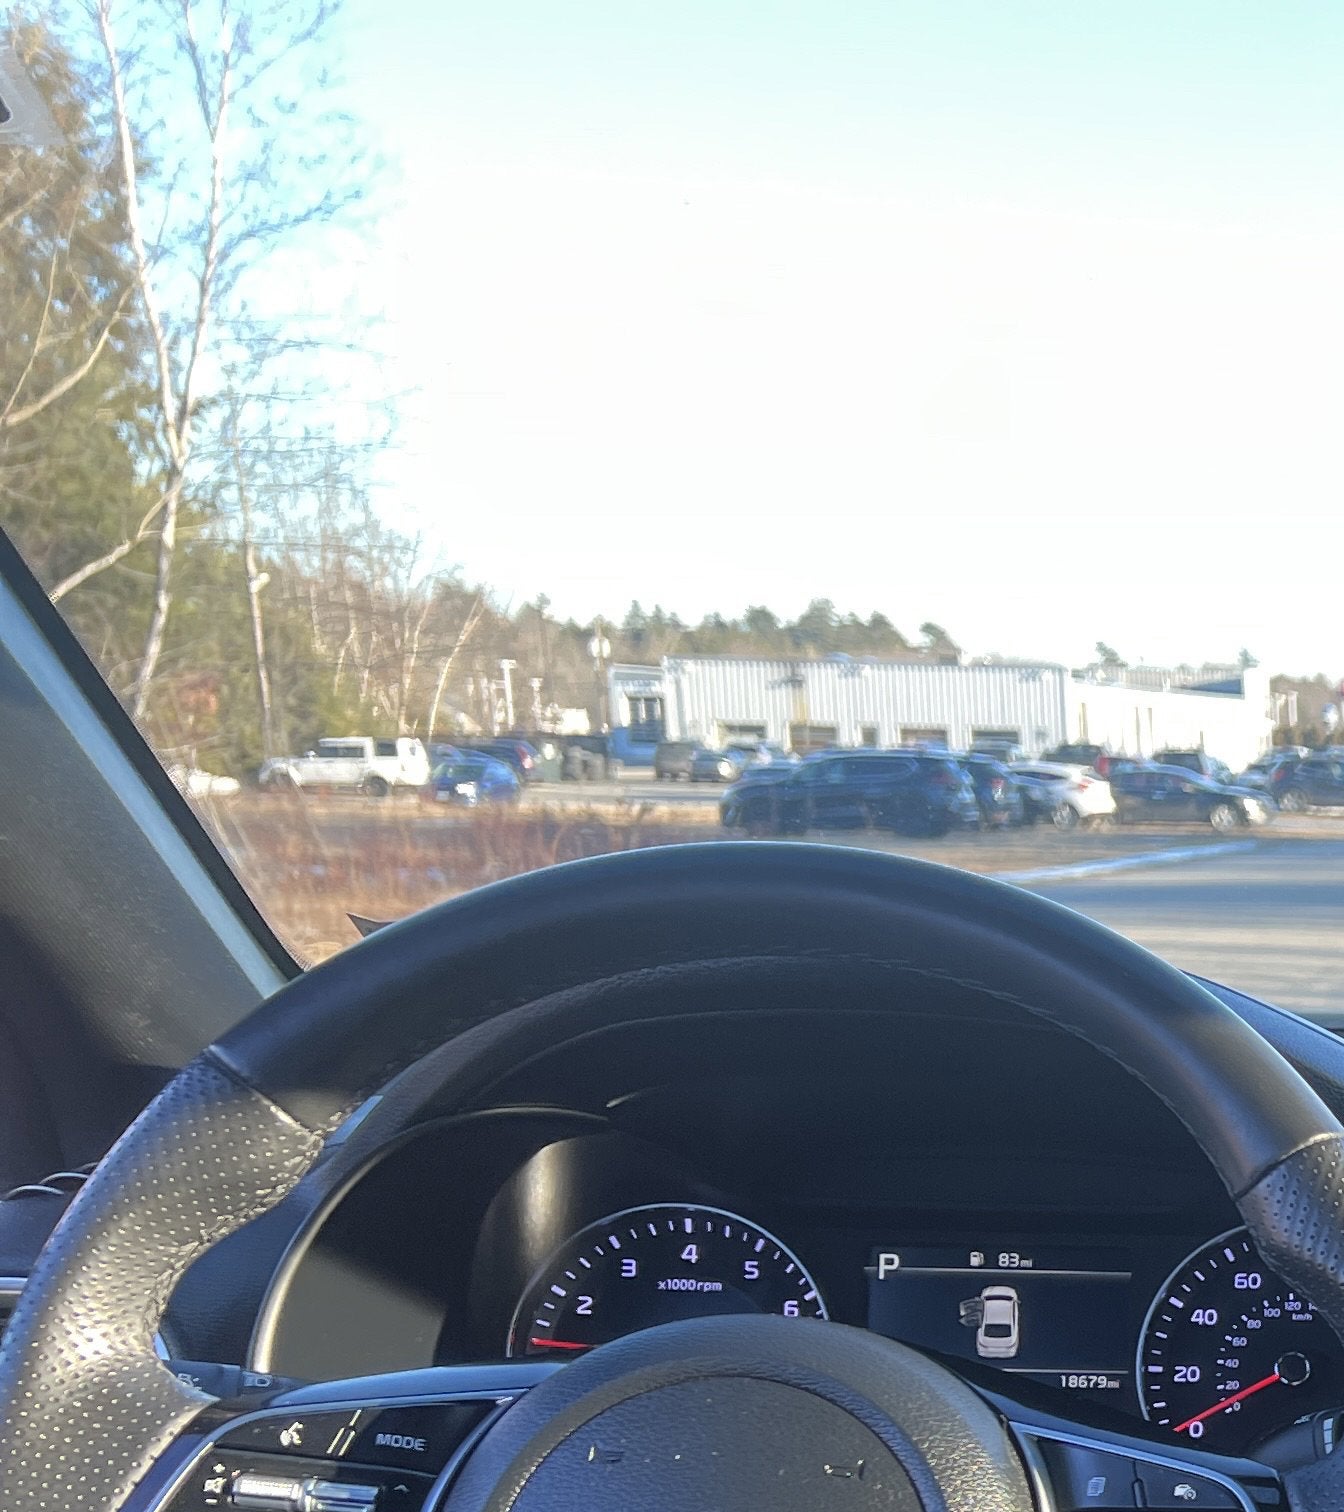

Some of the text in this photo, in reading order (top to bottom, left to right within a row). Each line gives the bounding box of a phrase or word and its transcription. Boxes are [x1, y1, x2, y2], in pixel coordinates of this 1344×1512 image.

[681, 1244, 698, 1264] 4
[621, 1258, 637, 1278] 3
[743, 1260, 760, 1280] 5
[878, 1253, 899, 1280] P
[1234, 1272, 1261, 1289] 60
[575, 1295, 593, 1315] 2
[783, 1300, 799, 1318] 6
[1263, 1308, 1281, 1318] 100
[1284, 1301, 1302, 1311] 120
[1190, 1308, 1218, 1326] 40
[1224, 1358, 1240, 1368] 40
[1173, 1365, 1201, 1383] 20
[1225, 1379, 1240, 1390] 20
[1233, 1401, 1241, 1412] 0
[1188, 1420, 1204, 1438] 0
[375, 1432, 428, 1452] MODE
